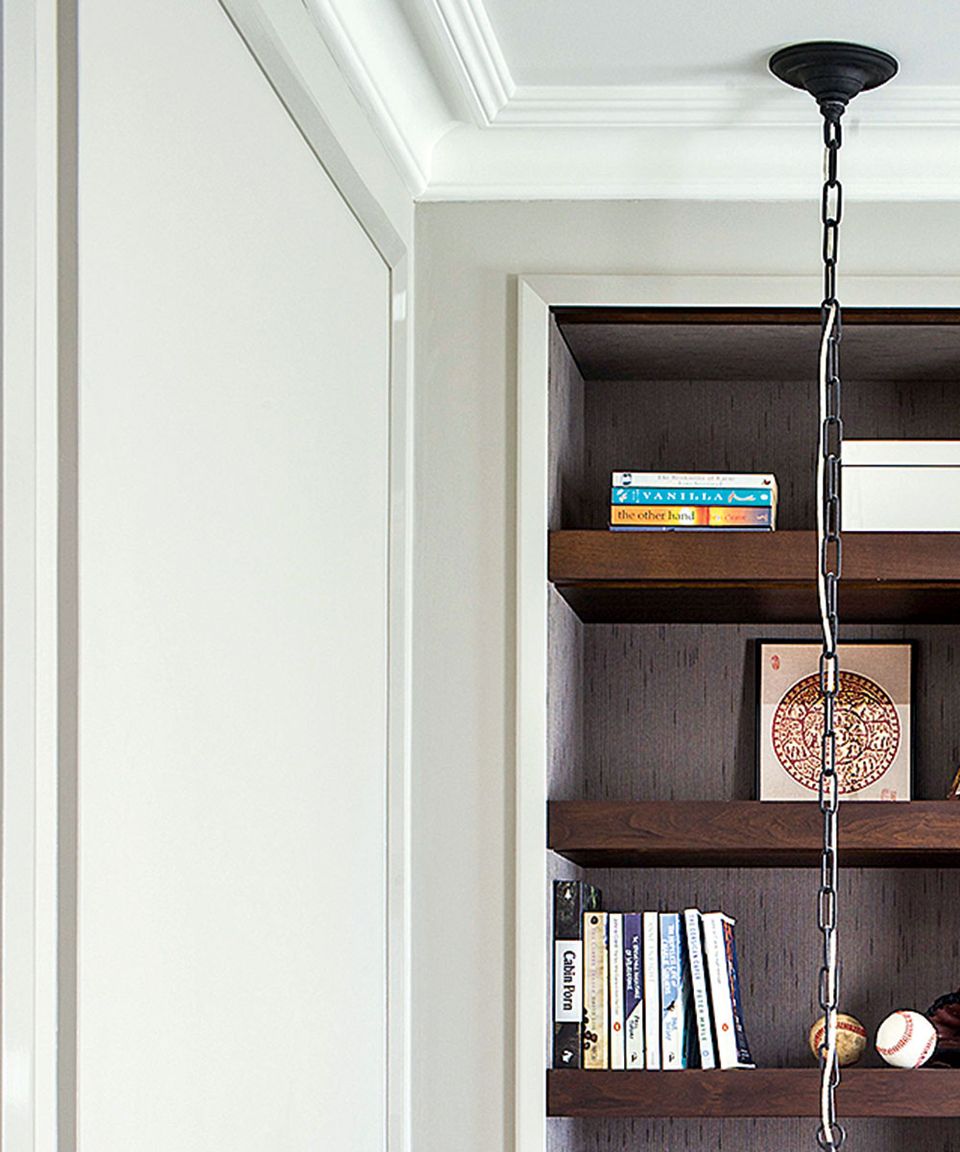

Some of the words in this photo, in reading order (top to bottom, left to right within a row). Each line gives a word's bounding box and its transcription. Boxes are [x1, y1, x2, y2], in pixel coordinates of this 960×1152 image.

[643, 491, 723, 501] VANILLA
[617, 510, 636, 520] the
[637, 510, 665, 521] other
[667, 510, 695, 521] hand
[690, 928, 698, 959] CORSICAN
[563, 950, 576, 983] Cabin
[693, 960, 701, 980] CAPER
[563, 985, 576, 1011] Porn
[696, 989, 704, 1013] PETER
[699, 1017, 707, 1041] MAYLE
